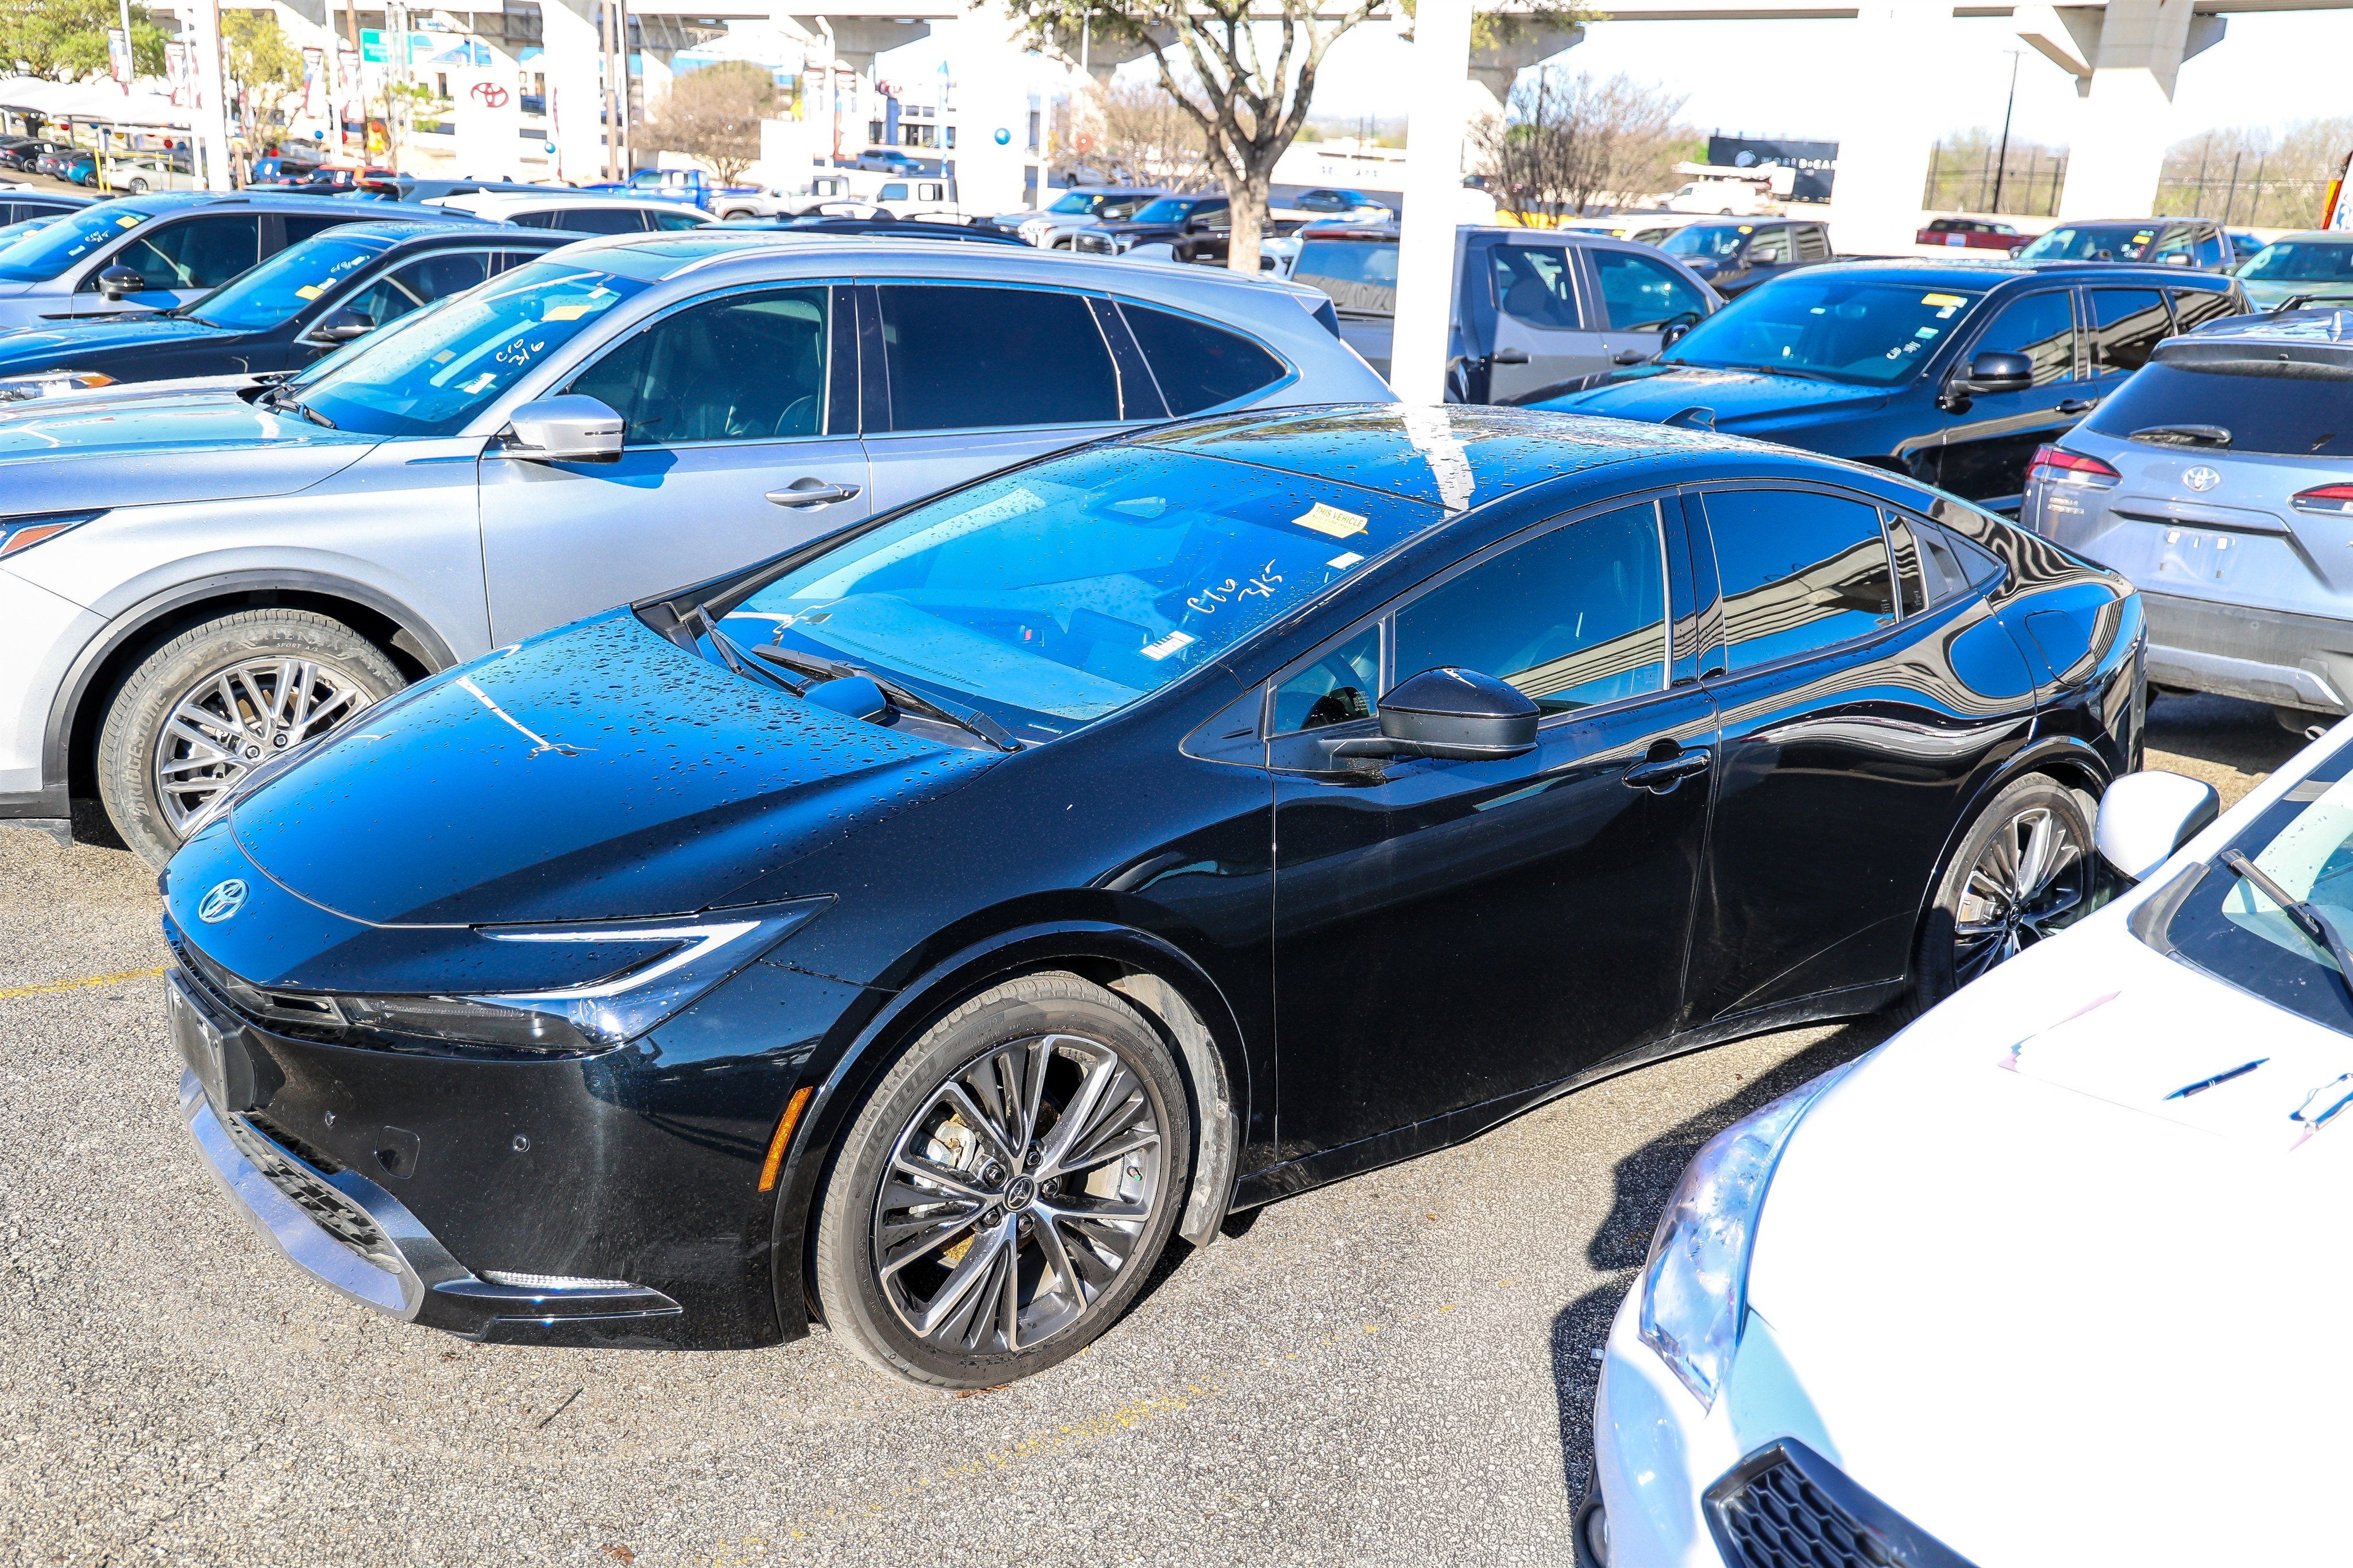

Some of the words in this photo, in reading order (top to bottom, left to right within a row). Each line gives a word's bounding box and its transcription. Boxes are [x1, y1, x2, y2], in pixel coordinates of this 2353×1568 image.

[508, 341, 545, 366] 3/6
[1316, 506, 1332, 517] THIS
[1333, 512, 1364, 527] VEHICLE
[1238, 558, 1282, 601] 3/5
[126, 693, 167, 817] BRIDGESTONE
[989, 1017, 998, 1028] 19
[862, 1061, 932, 1169] MICHELIN
